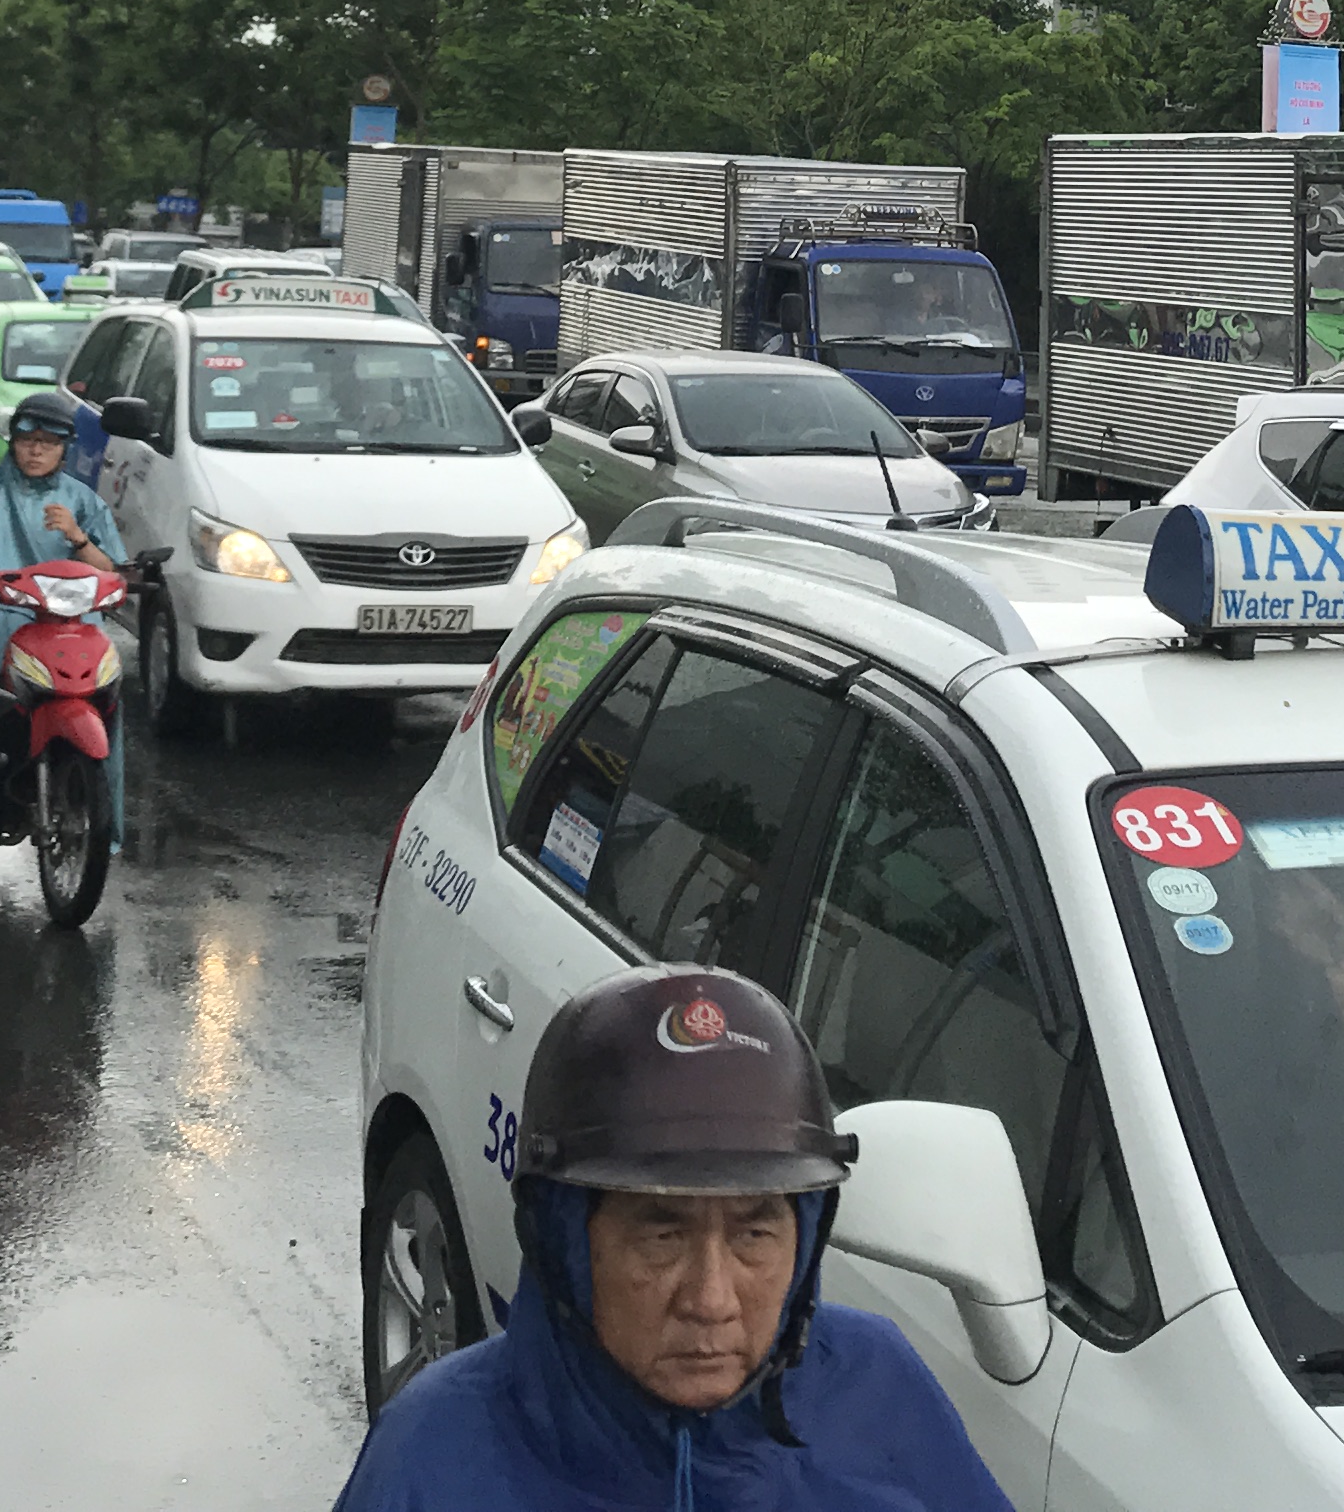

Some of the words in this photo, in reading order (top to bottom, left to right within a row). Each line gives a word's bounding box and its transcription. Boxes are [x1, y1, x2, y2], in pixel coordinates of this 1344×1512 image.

[251, 286, 331, 303] VINASUN
[333, 289, 369, 306] TAXI
[1222, 589, 1291, 620] Water
[1115, 801, 1238, 853] 831
[1162, 883, 1199, 896] 09/17
